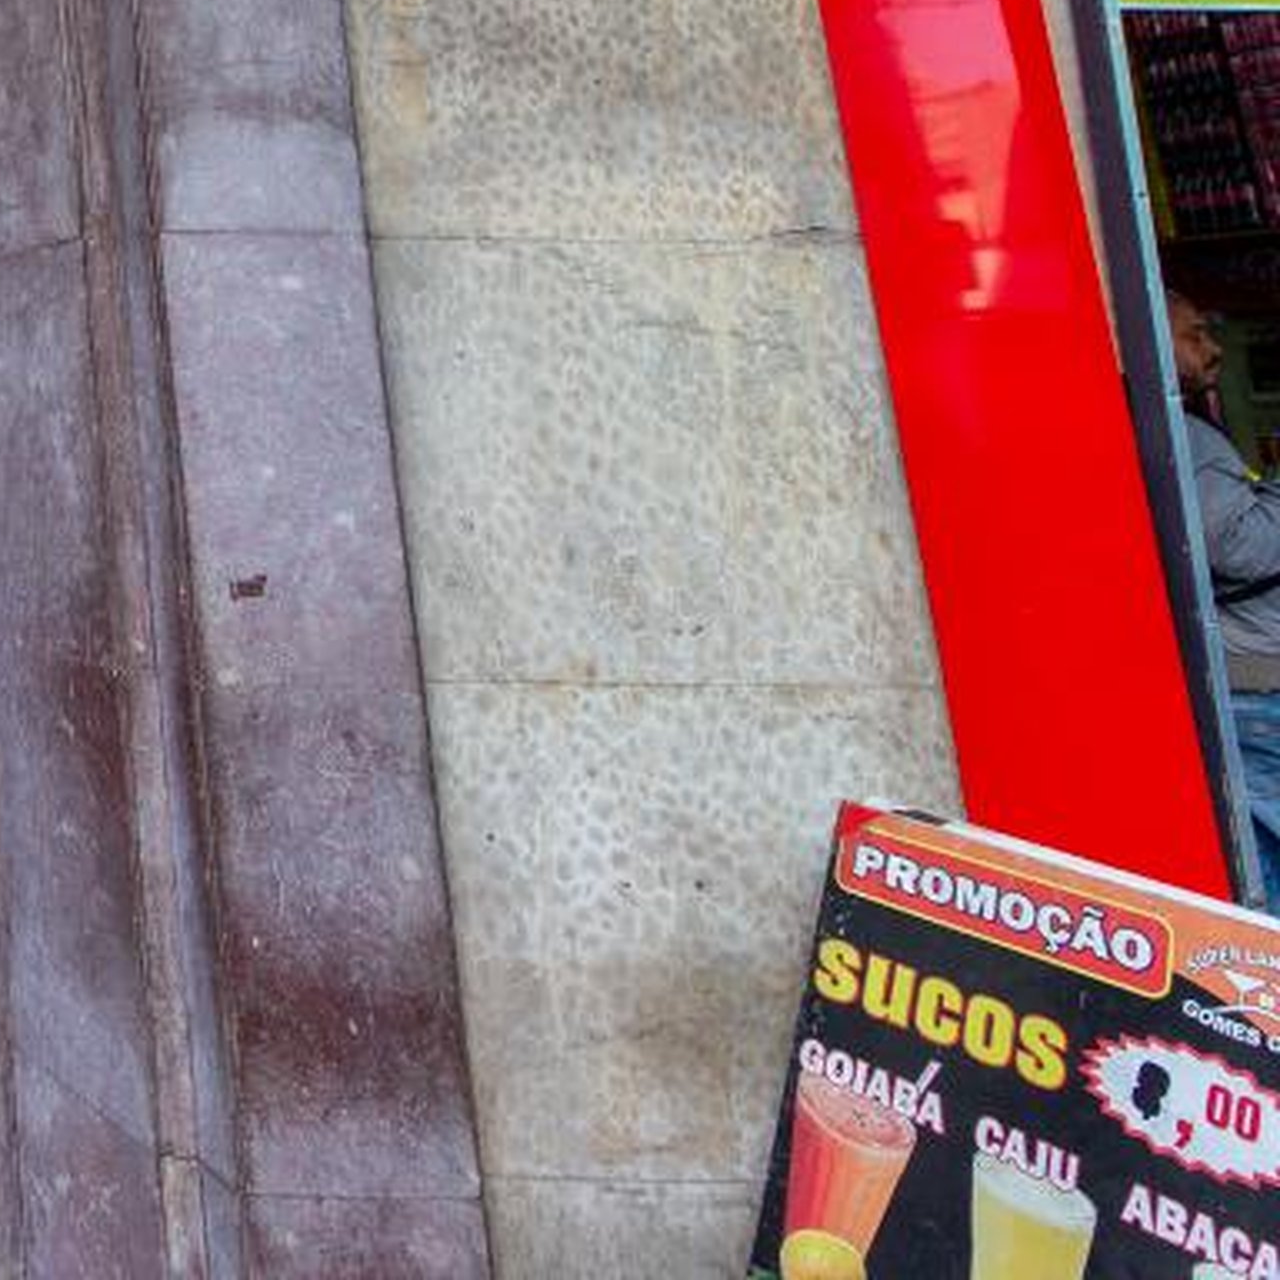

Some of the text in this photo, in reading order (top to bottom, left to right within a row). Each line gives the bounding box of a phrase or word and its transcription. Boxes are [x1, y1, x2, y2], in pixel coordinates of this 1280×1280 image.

[851, 844, 1155, 972] PROMOÇÃO
[813, 937, 1070, 1092] SUCOS
[1182, 999, 1261, 1048] GOMES
[974, 1115, 1081, 1191] CAJU
